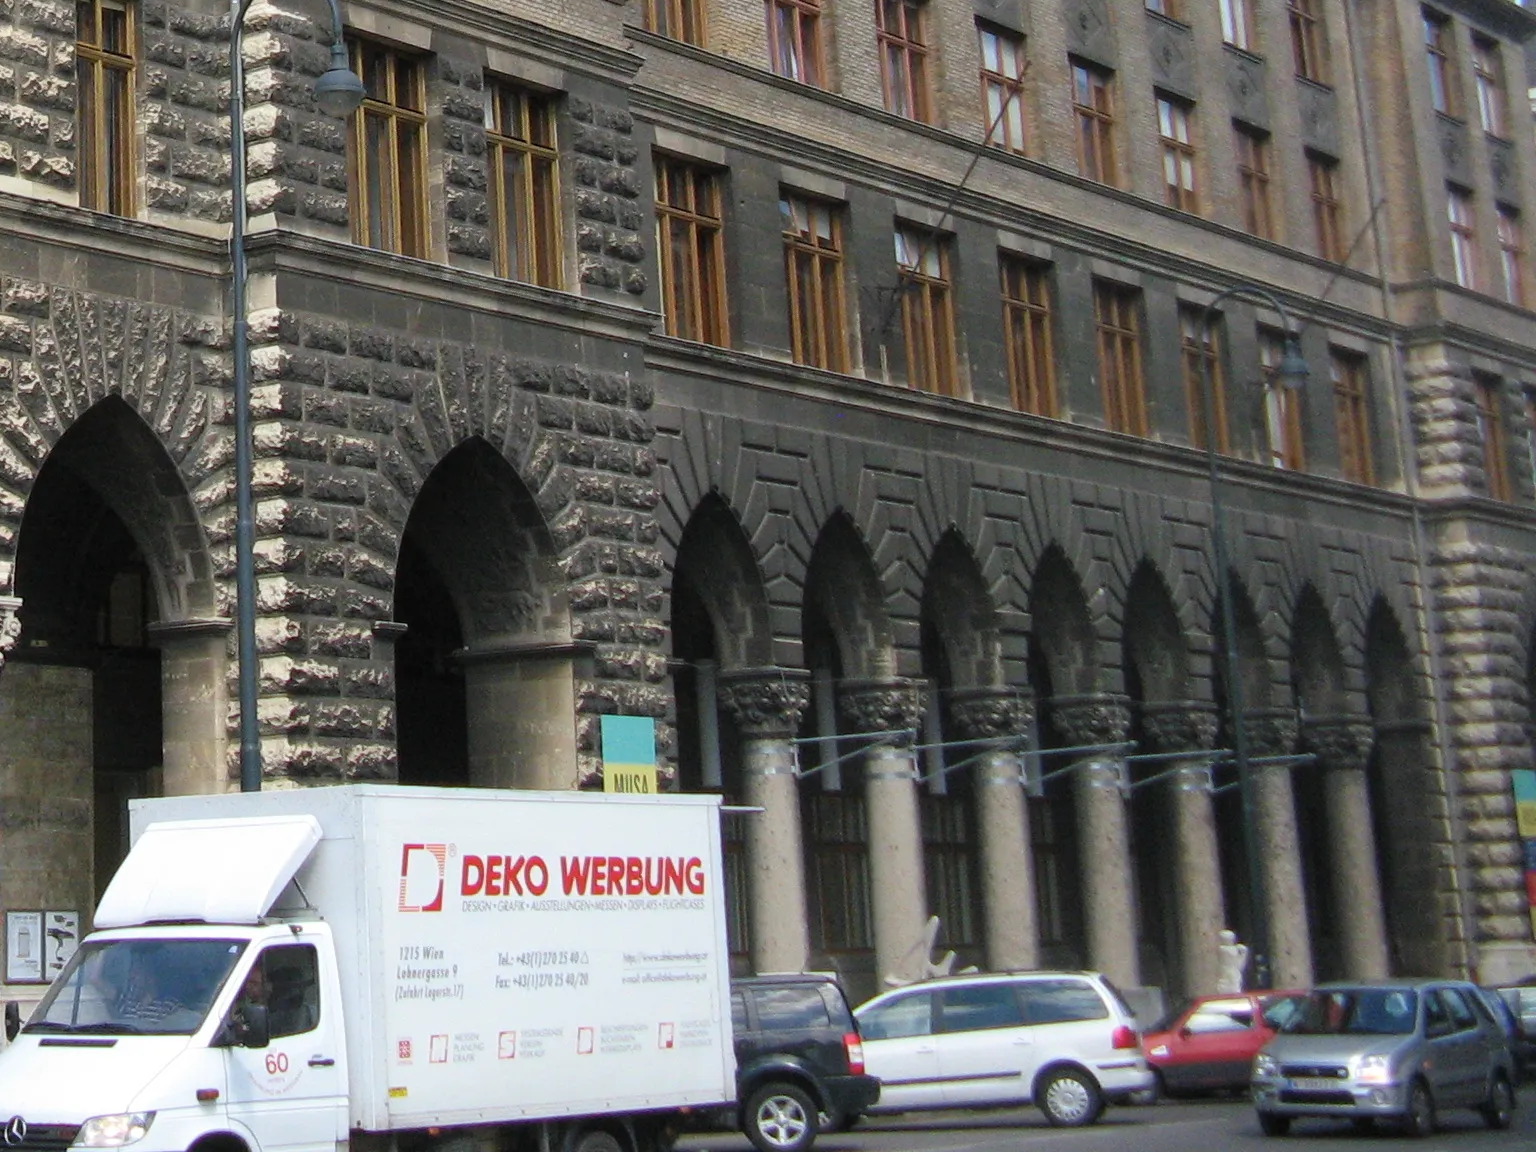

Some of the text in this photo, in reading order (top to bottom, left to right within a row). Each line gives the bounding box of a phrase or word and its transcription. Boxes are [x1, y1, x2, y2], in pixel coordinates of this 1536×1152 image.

[460, 854, 705, 897] DEKO WERBUNG
[462, 898, 704, 913] DESIGN GRAFIK AUSSTELLUNGEN MESSEN DISPLAYS FLIGHTCASES
[399, 946, 444, 960] 1215 Wien
[265, 1052, 288, 1075] 60
